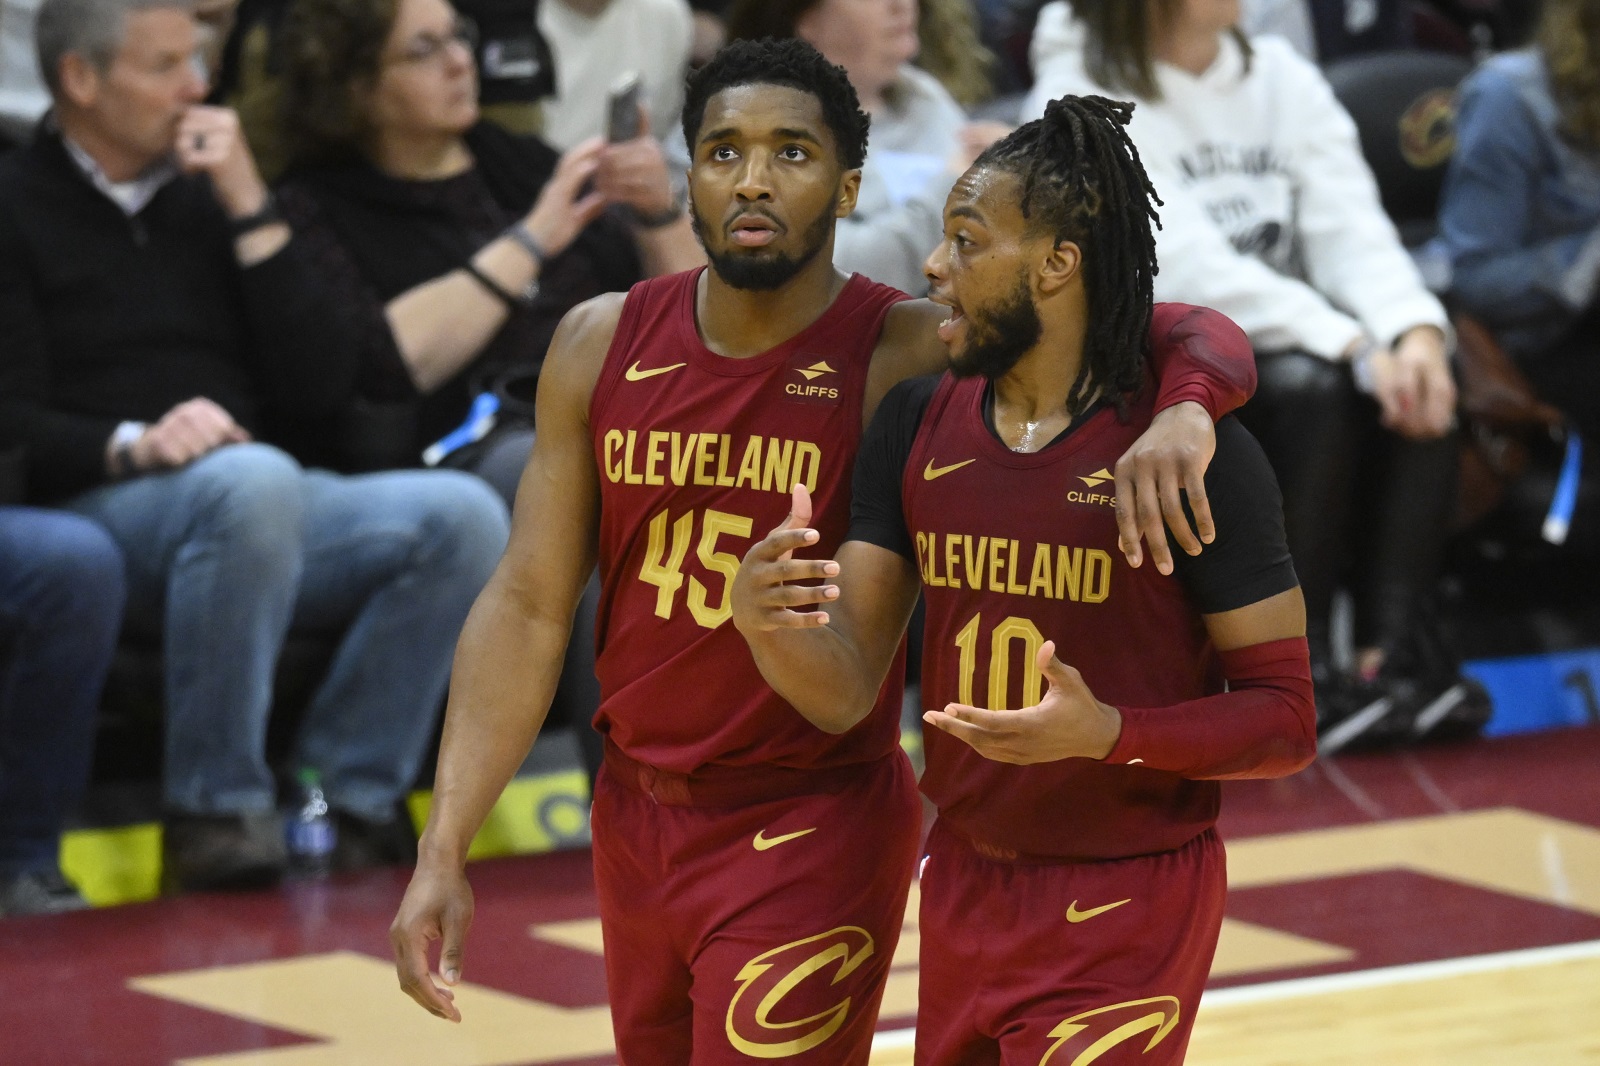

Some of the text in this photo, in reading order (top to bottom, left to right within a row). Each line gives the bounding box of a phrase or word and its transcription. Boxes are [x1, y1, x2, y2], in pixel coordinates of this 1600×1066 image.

[785, 383, 838, 399] CLIFFS
[604, 429, 821, 495] CLEVELAND
[1067, 491, 1116, 507] CLIFFS
[638, 508, 753, 629] 45
[916, 531, 1112, 603] CLEVELAND
[955, 612, 1044, 710] 10
